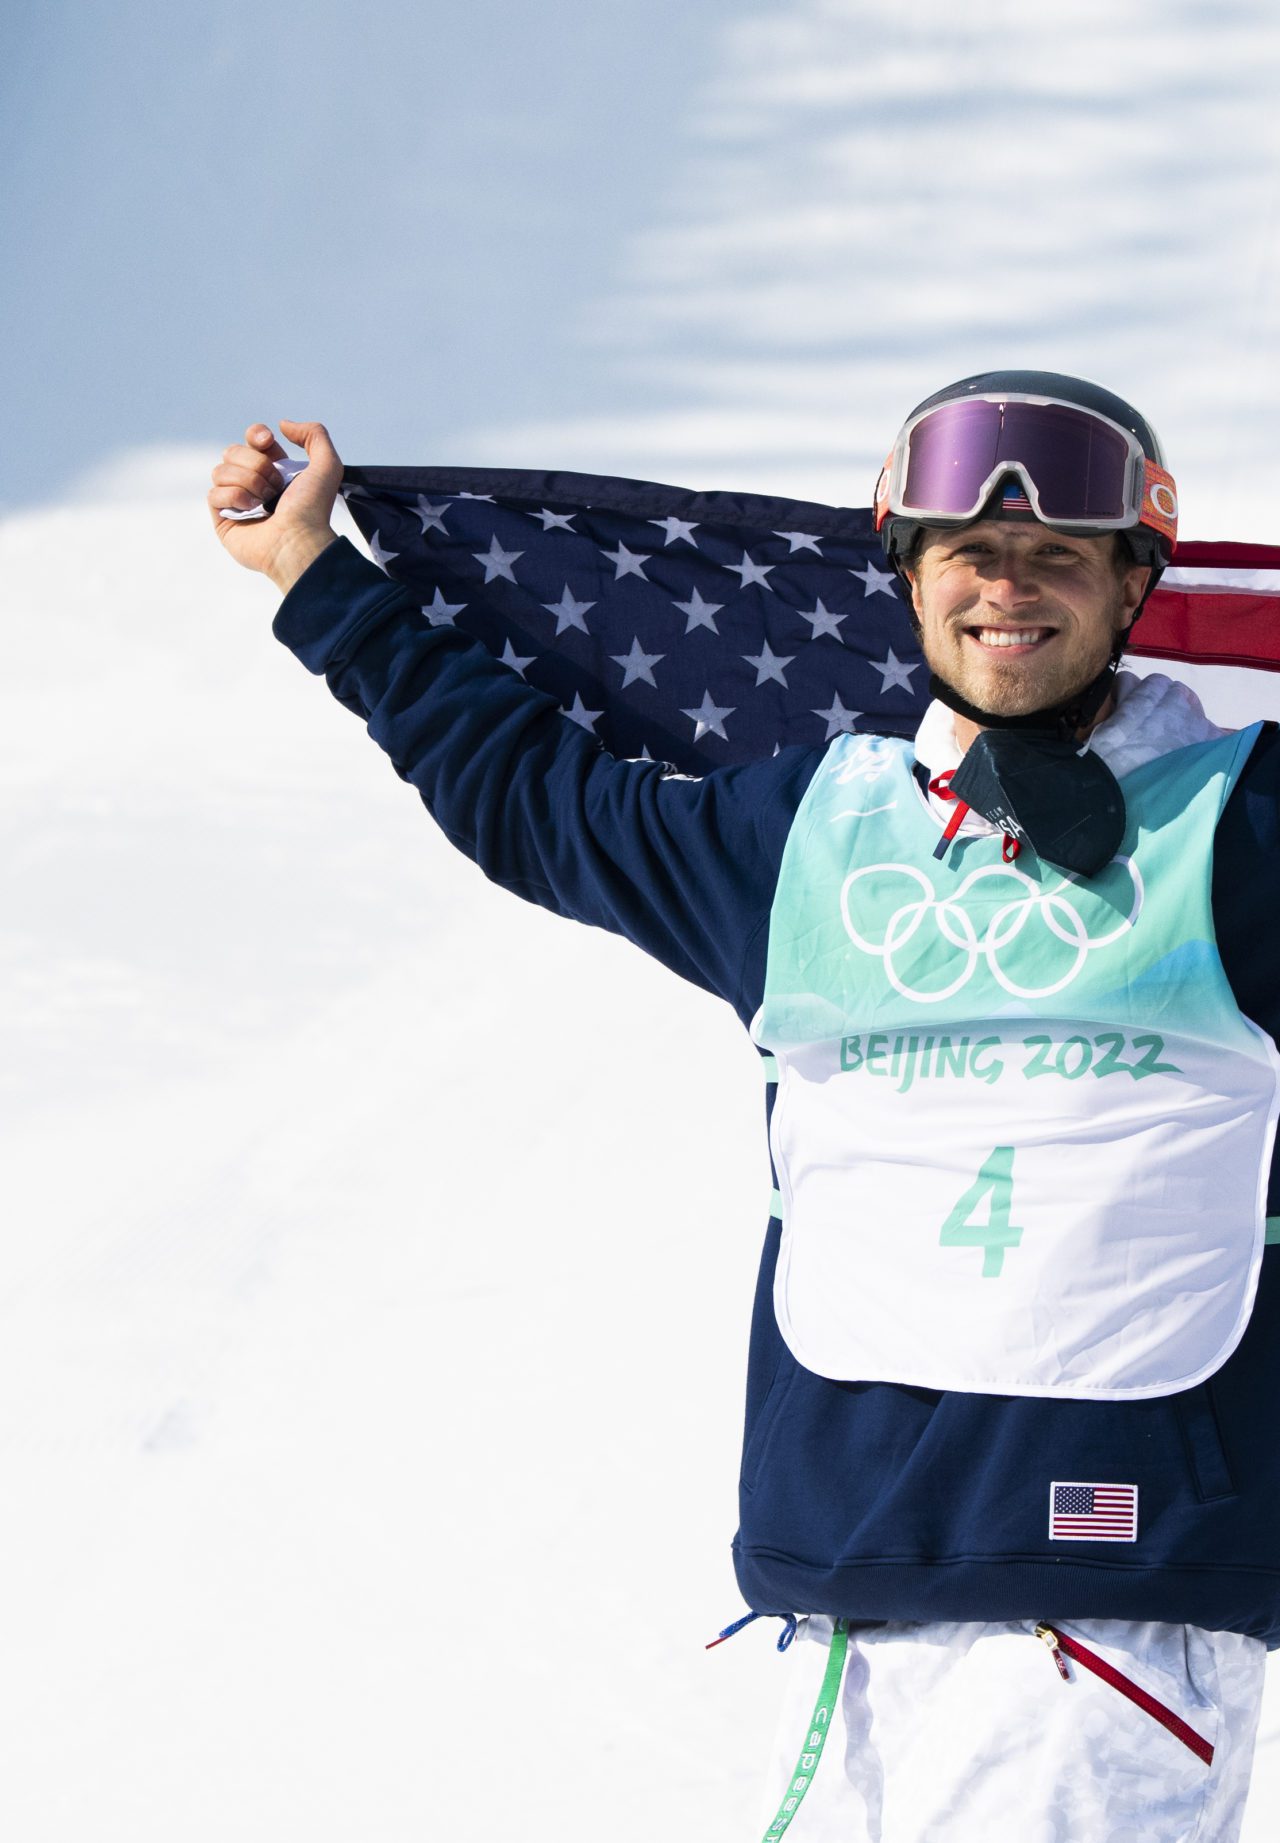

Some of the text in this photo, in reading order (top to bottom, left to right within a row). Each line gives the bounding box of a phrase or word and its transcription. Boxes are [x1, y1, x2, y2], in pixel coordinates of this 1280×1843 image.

[985, 806, 1005, 820] TEAM
[840, 1033, 1184, 1093] BEIJING 2022
[938, 1146, 1025, 1278] 4
